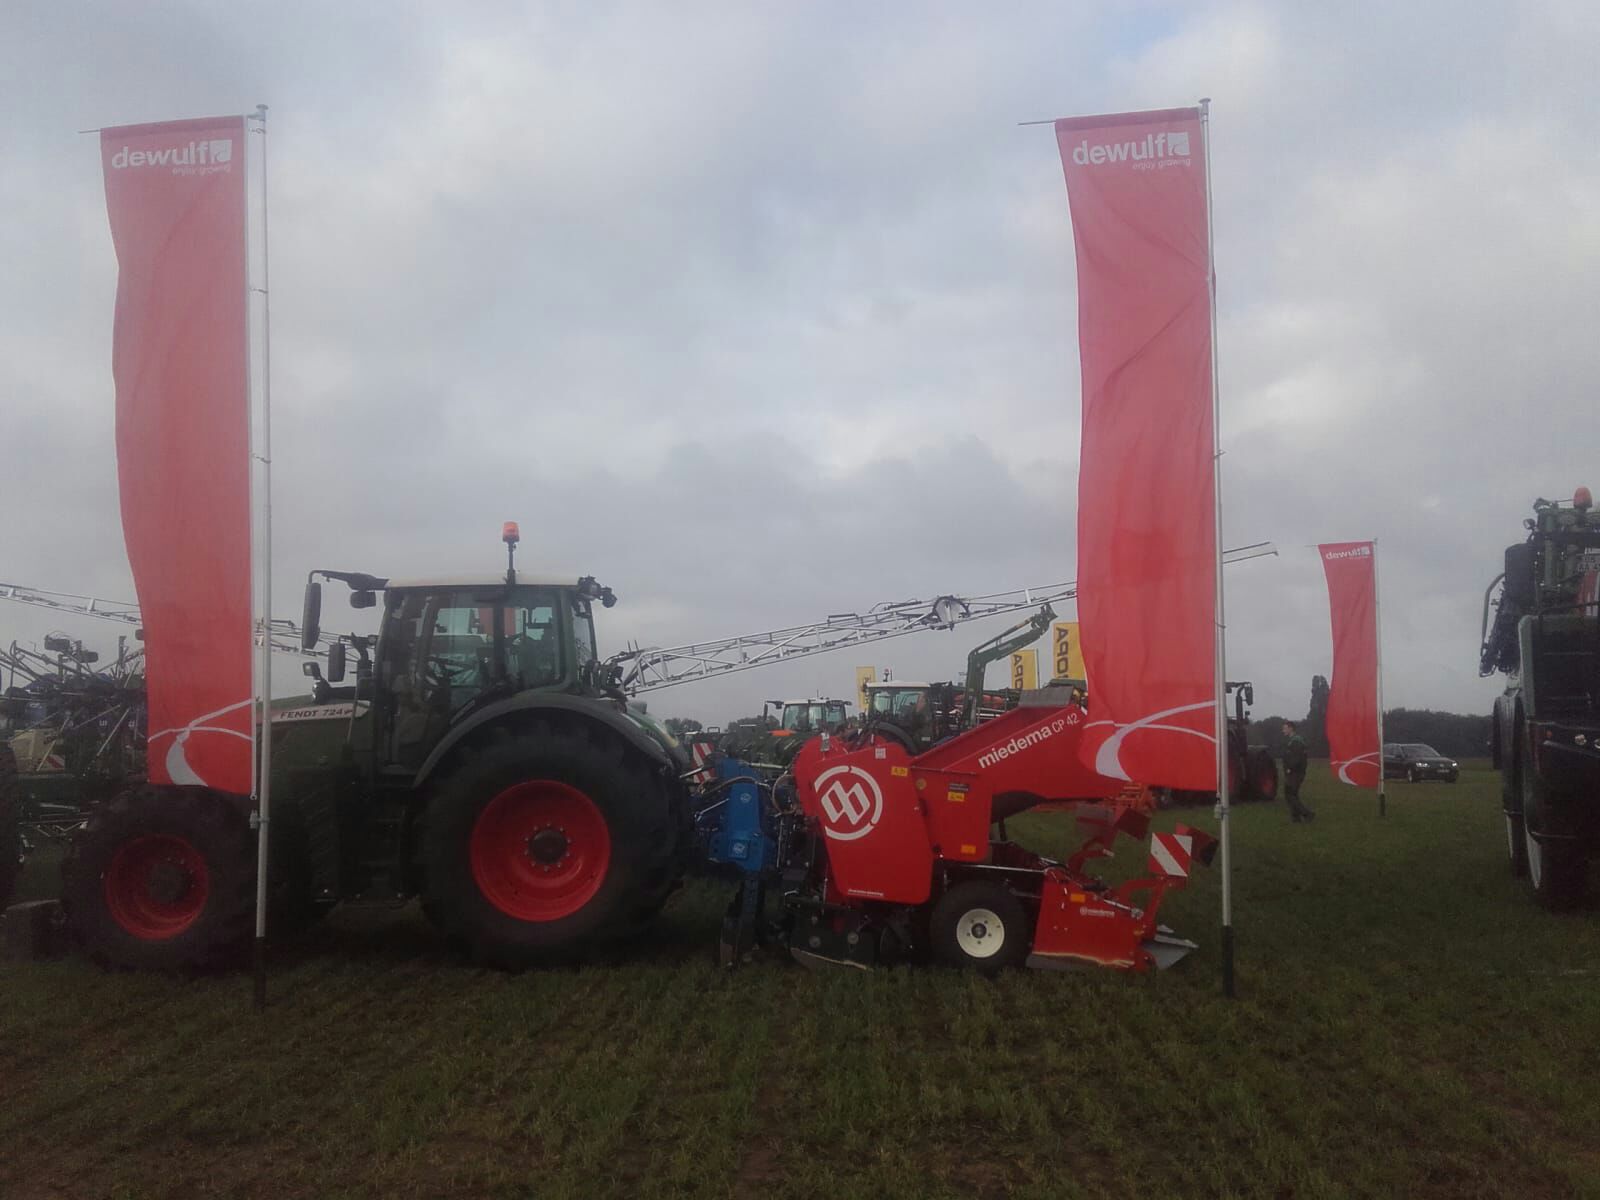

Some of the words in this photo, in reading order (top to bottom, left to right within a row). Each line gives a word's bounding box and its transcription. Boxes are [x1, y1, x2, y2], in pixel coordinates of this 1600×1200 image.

[111, 141, 208, 169] dewulf
[1072, 132, 1166, 165] dewulf
[280, 710, 318, 719] FENDT
[323, 708, 344, 717] 724
[978, 725, 1053, 769] miedema
[1051, 718, 1065, 734] CP
[1066, 712, 1080, 726] 42
